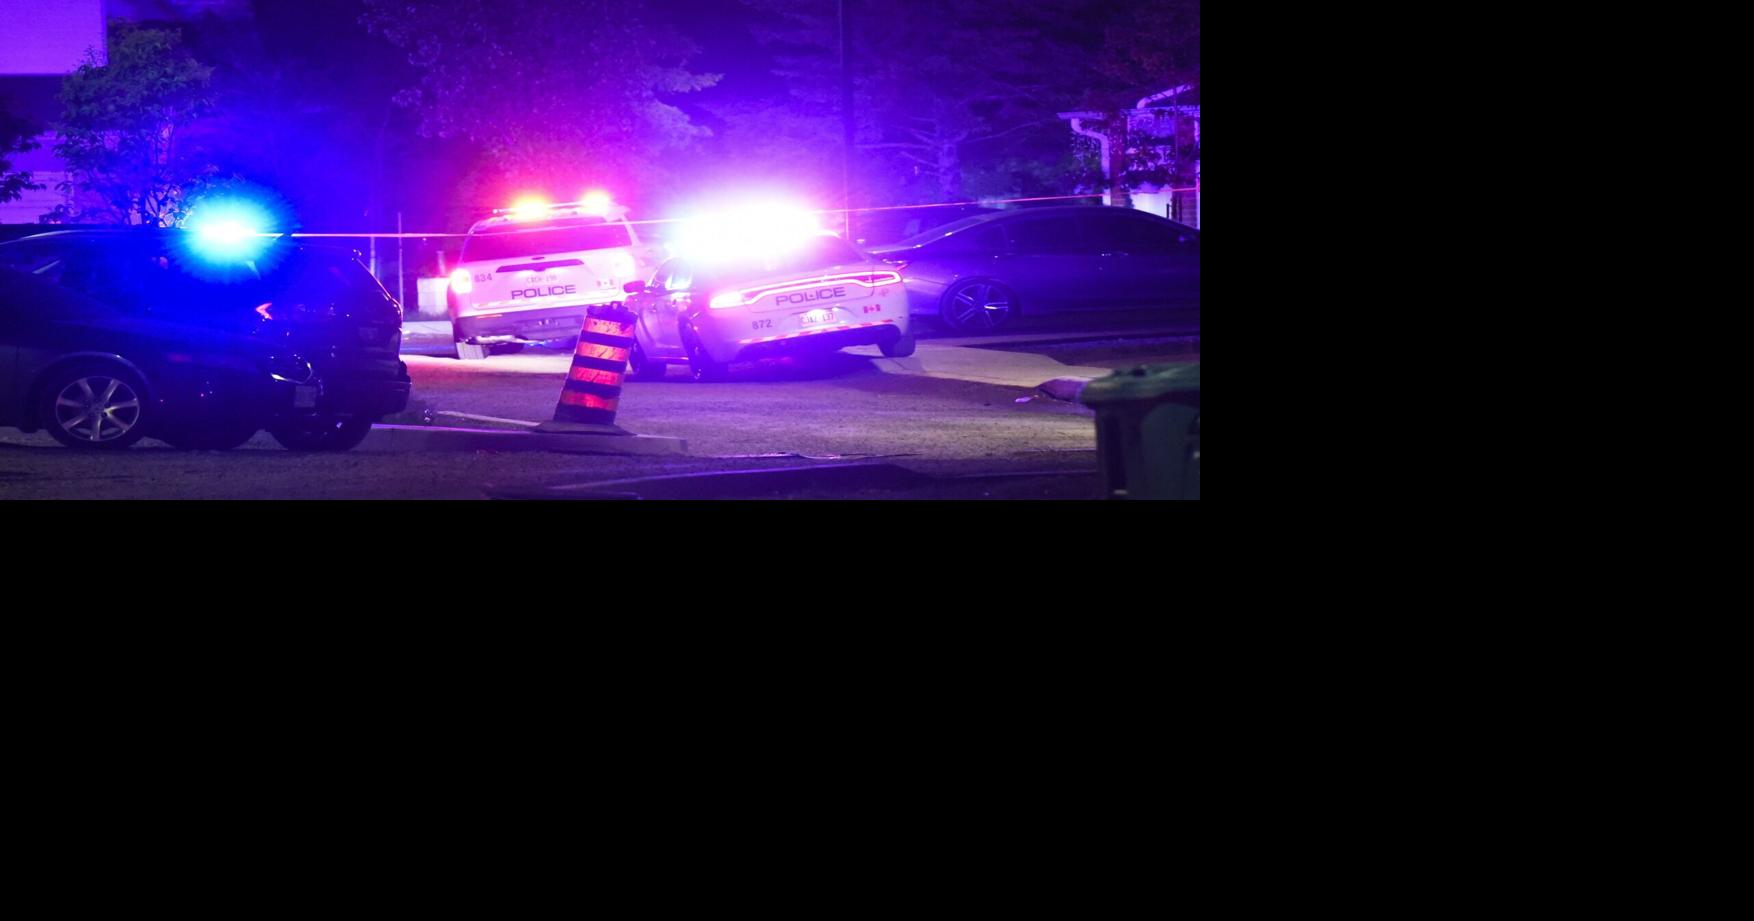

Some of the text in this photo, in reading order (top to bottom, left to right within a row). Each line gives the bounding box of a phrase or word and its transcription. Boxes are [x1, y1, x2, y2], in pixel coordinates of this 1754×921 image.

[511, 284, 577, 300] POLICE
[775, 286, 847, 306] POLICE
[752, 319, 773, 330] 872
